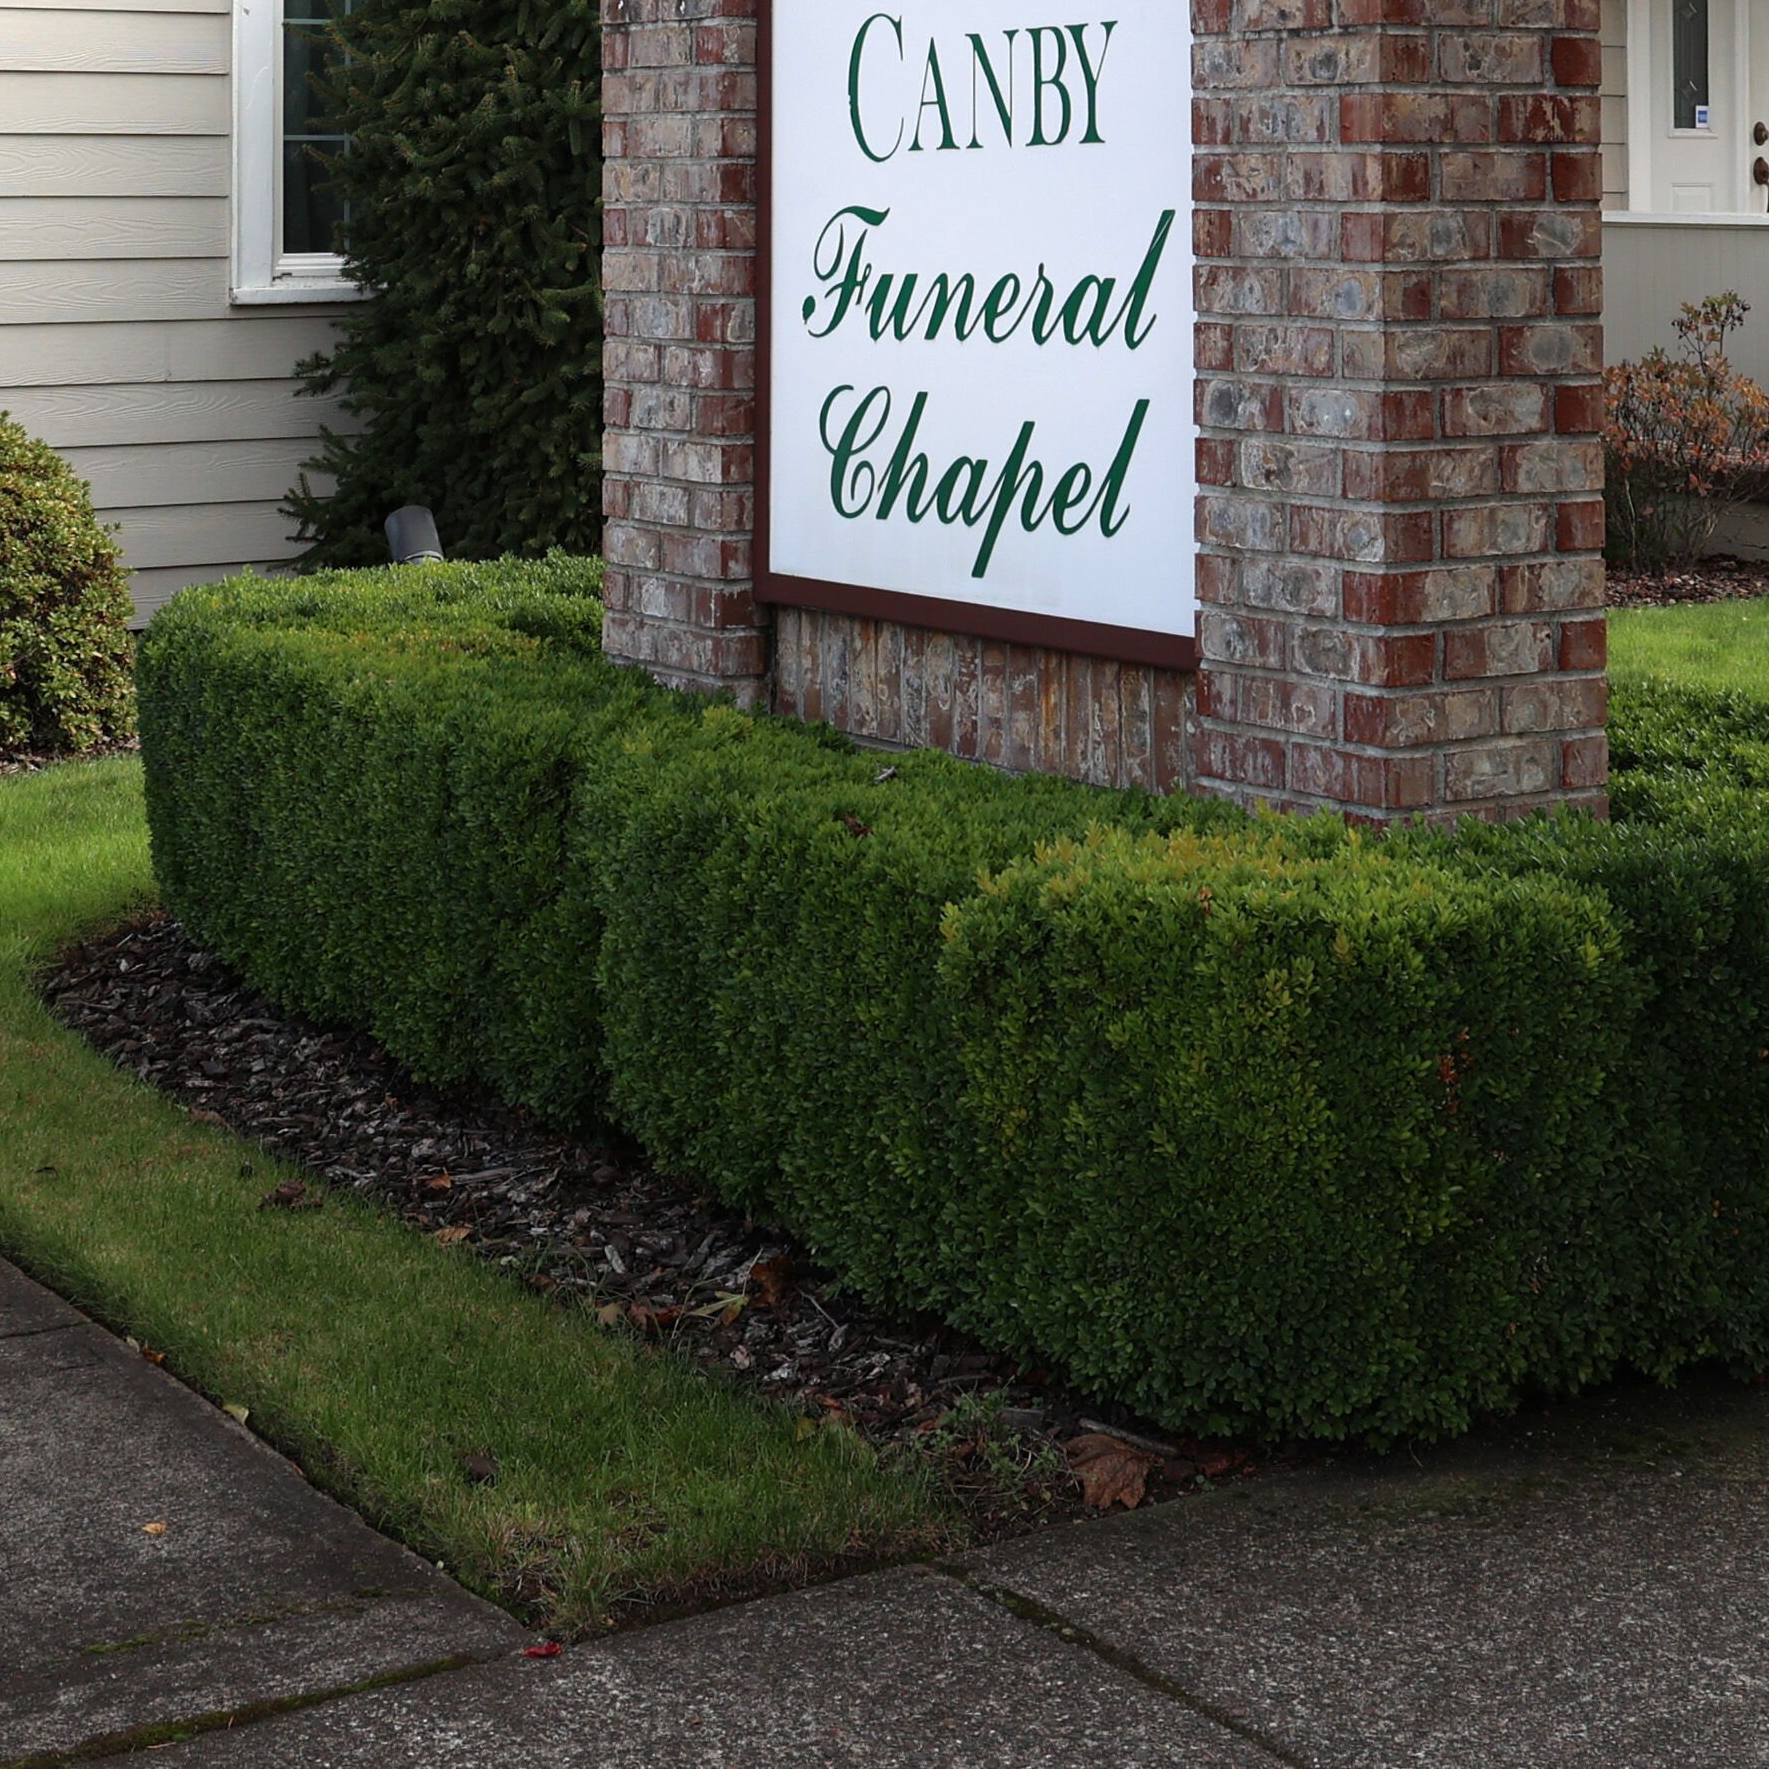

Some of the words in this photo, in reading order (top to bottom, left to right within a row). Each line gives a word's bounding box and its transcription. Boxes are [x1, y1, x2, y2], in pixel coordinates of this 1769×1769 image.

[846, 12, 1119, 164] CANBY
[801, 205, 1176, 351] Funeral
[818, 384, 1151, 579] Chapel
